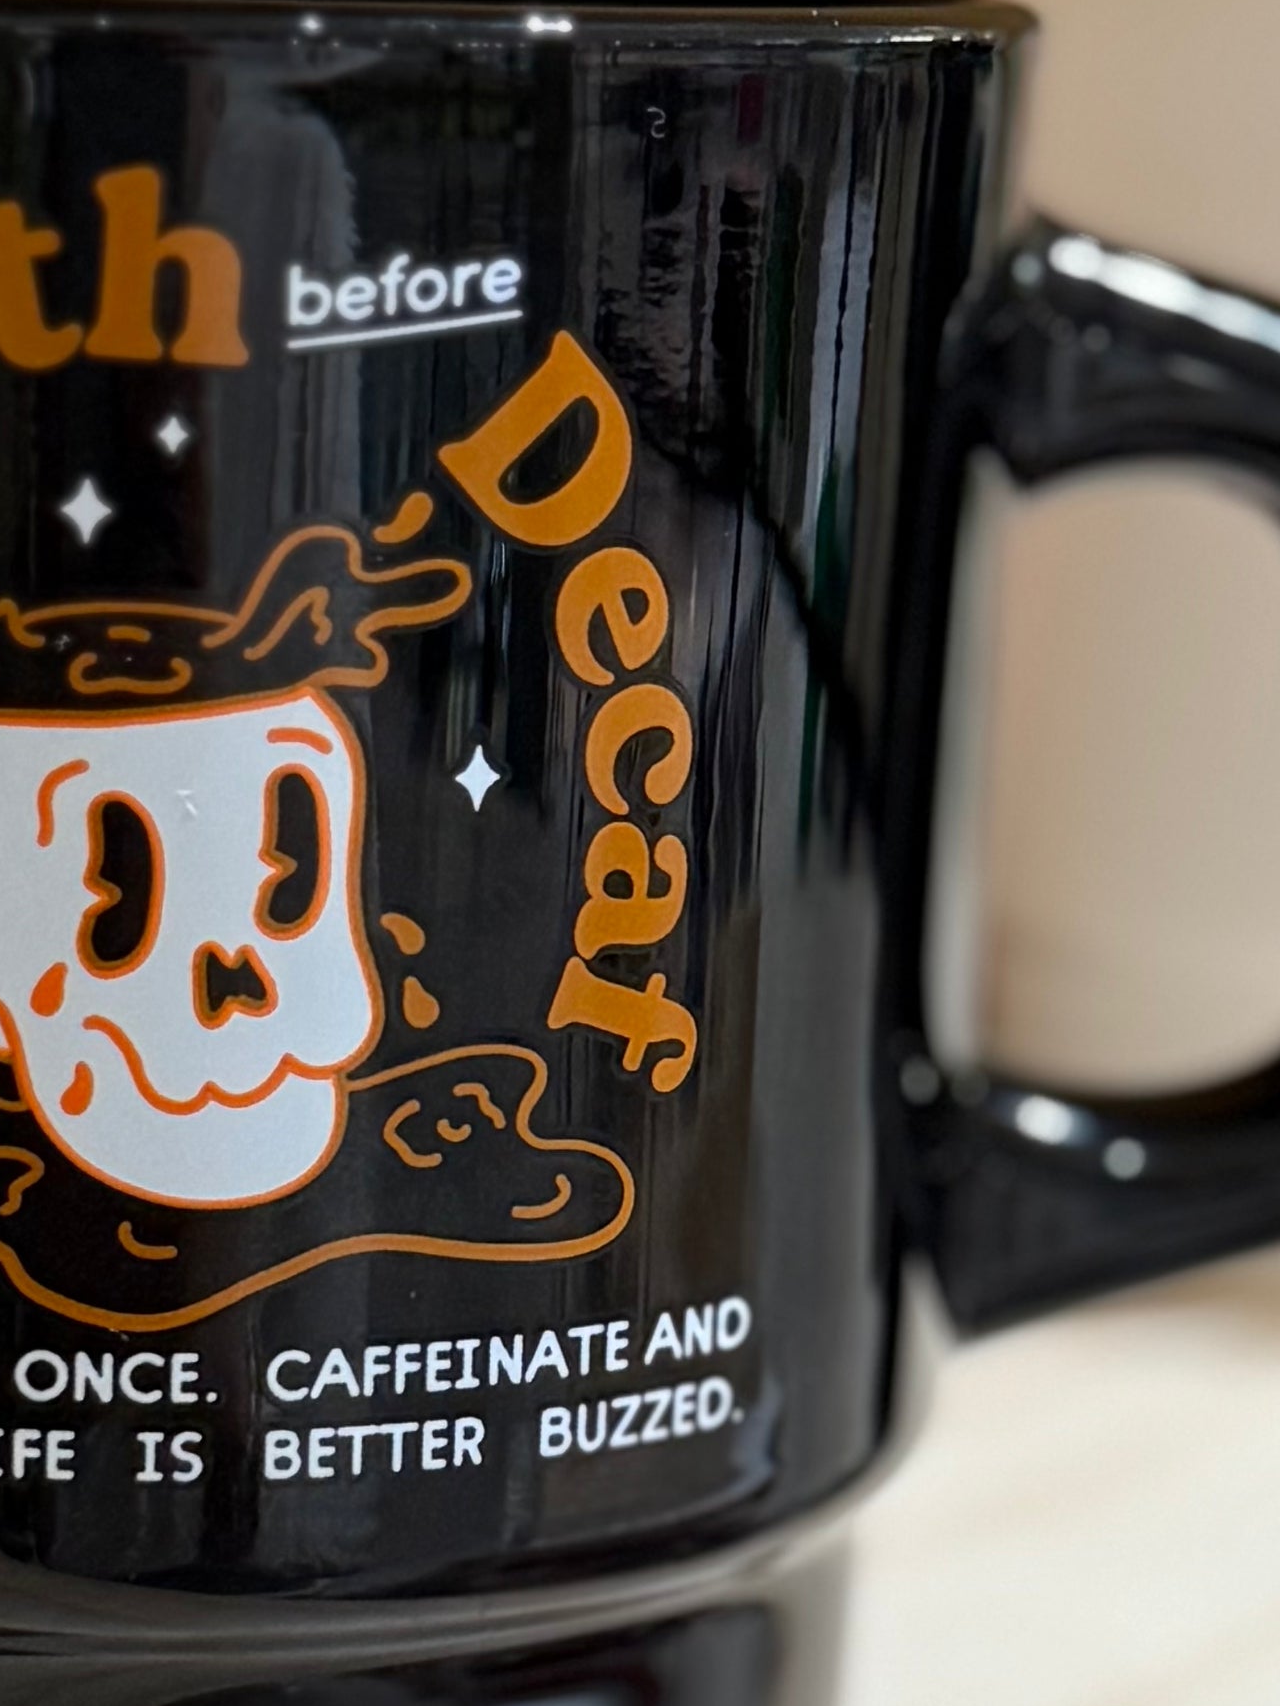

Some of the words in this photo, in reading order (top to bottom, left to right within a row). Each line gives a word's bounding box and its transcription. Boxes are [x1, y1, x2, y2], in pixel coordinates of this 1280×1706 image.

[286, 252, 523, 326] before
[437, 329, 697, 1094] Decaf
[13, 1348, 218, 1405] ONCE.
[265, 1319, 631, 1403] CAFFEINATE
[642, 1295, 752, 1367] AND
[135, 1430, 204, 1483] IS
[263, 1404, 486, 1481] BETTER
[538, 1375, 744, 1459] BUZZED.
